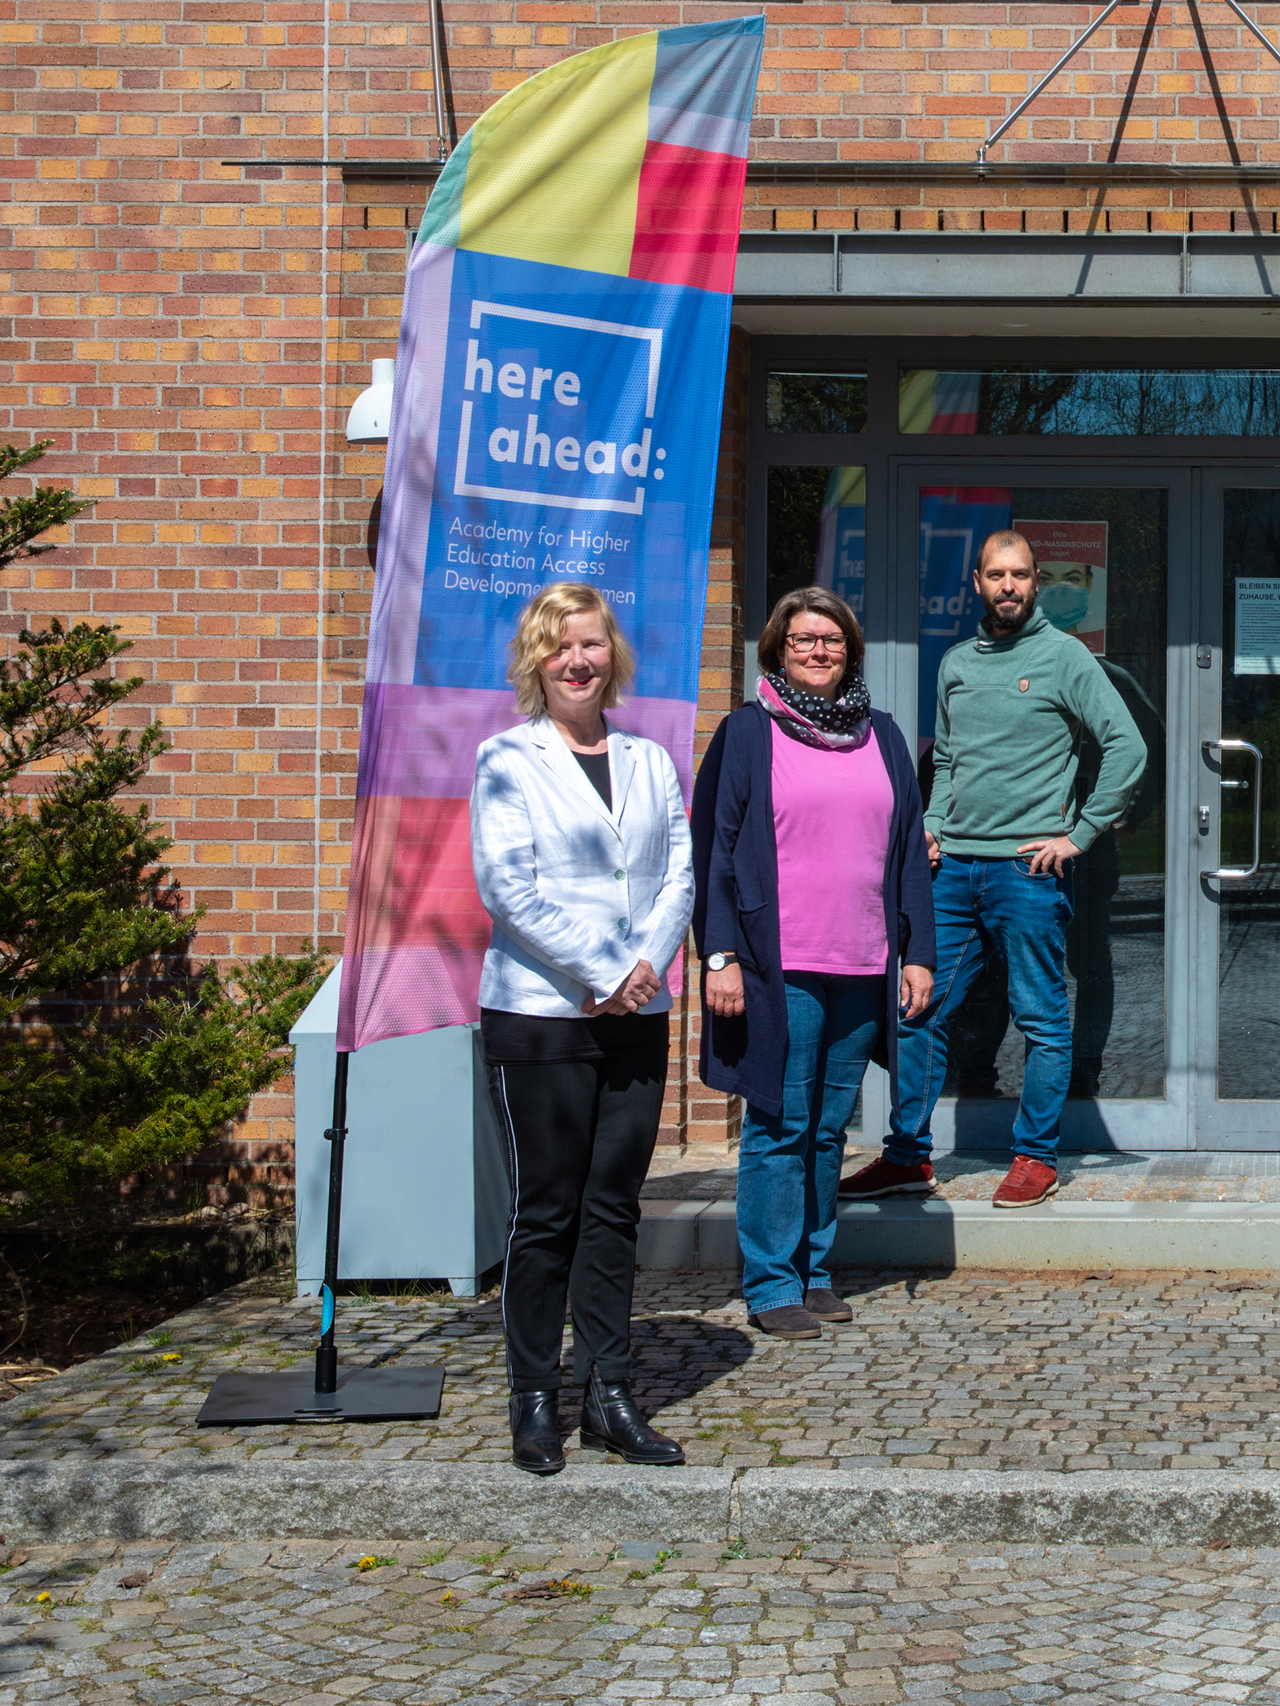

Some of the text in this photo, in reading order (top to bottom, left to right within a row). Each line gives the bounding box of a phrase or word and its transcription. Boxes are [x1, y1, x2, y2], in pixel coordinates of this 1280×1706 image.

[463, 339, 581, 406] here
[488, 414, 666, 480] ahead:
[449, 517, 630, 553] Academy for Higher
[447, 543, 605, 575] Education Access
[445, 571, 547, 599] Developme
